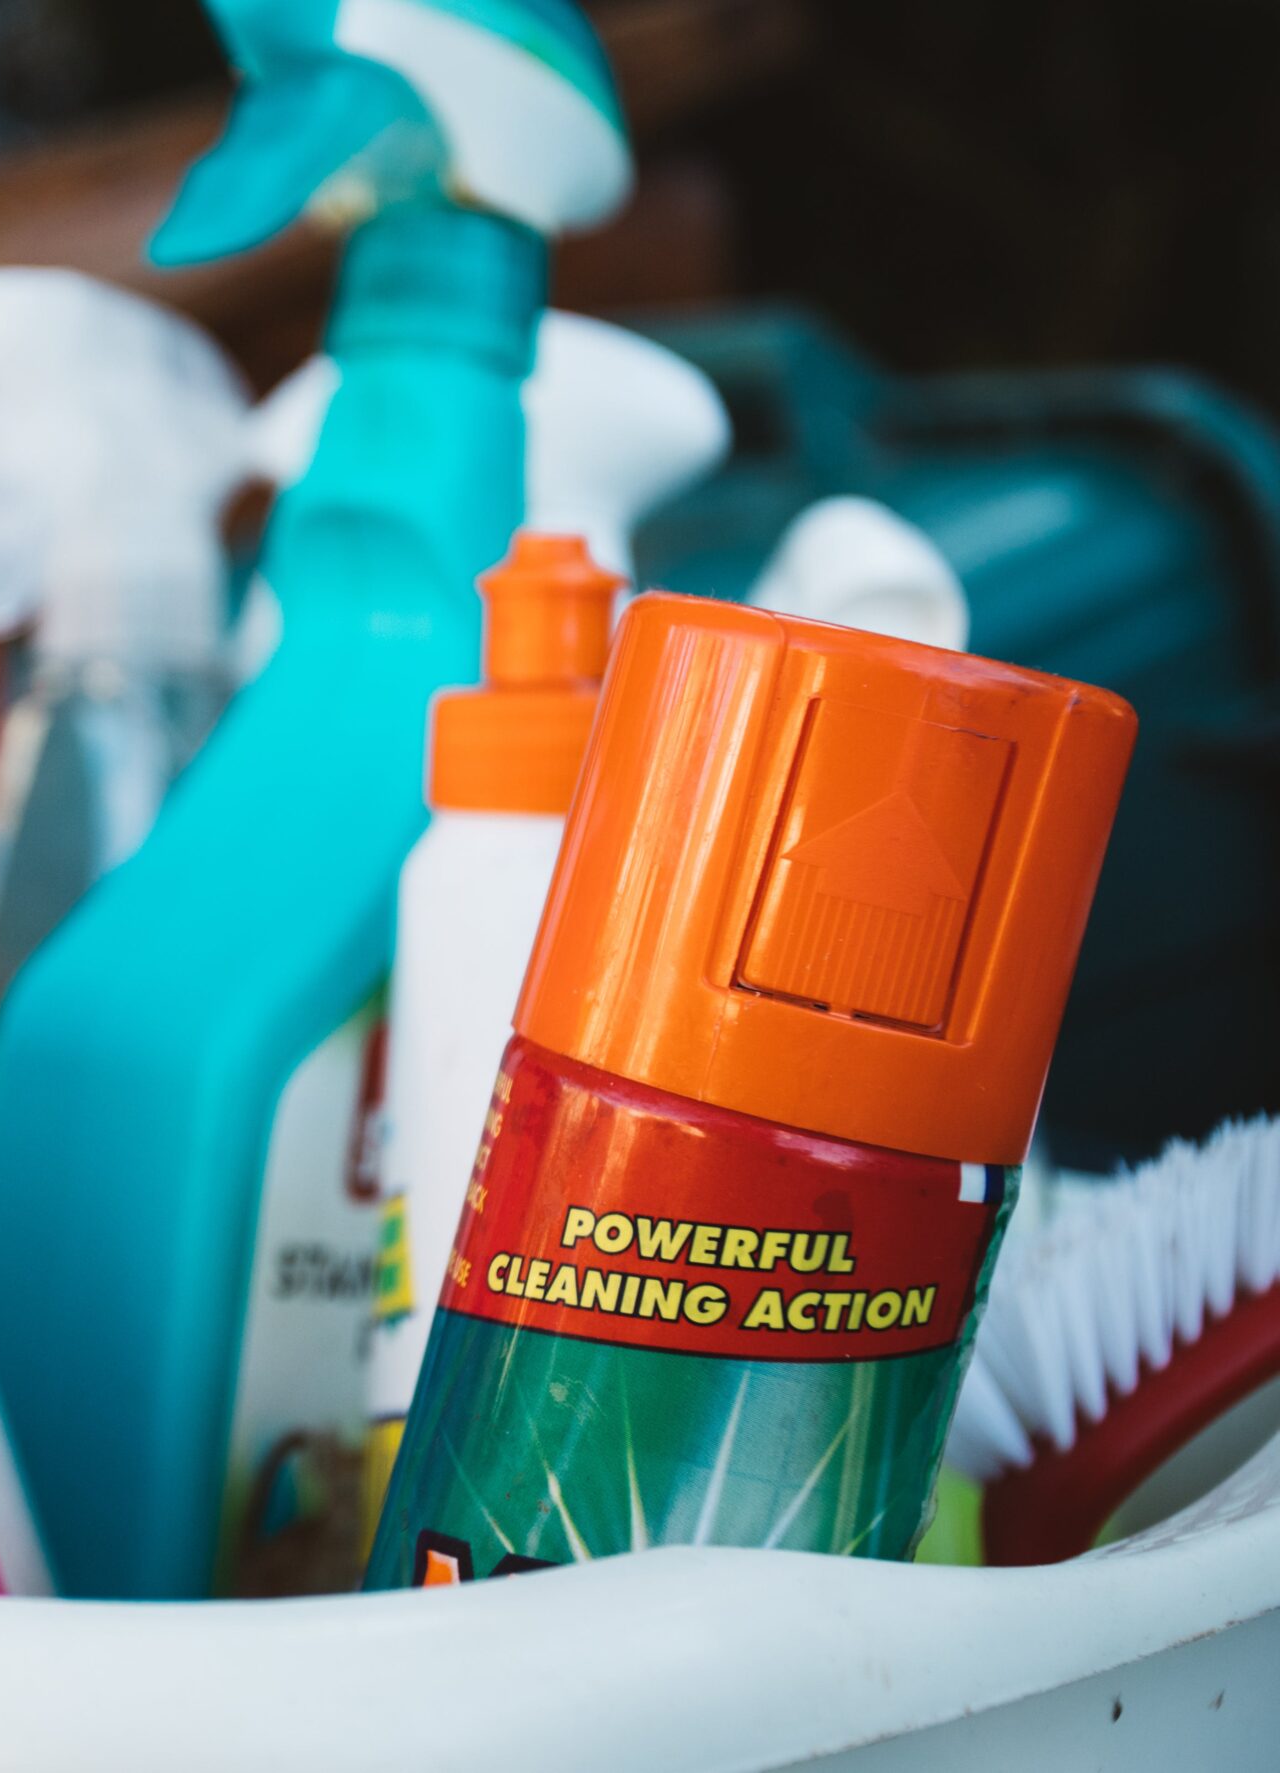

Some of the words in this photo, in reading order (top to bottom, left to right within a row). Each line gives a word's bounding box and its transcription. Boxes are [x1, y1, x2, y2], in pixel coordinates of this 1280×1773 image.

[562, 1206, 855, 1274] POWERFUL
[486, 1253, 729, 1326] CLEANING
[739, 1285, 938, 1332] ACTION
